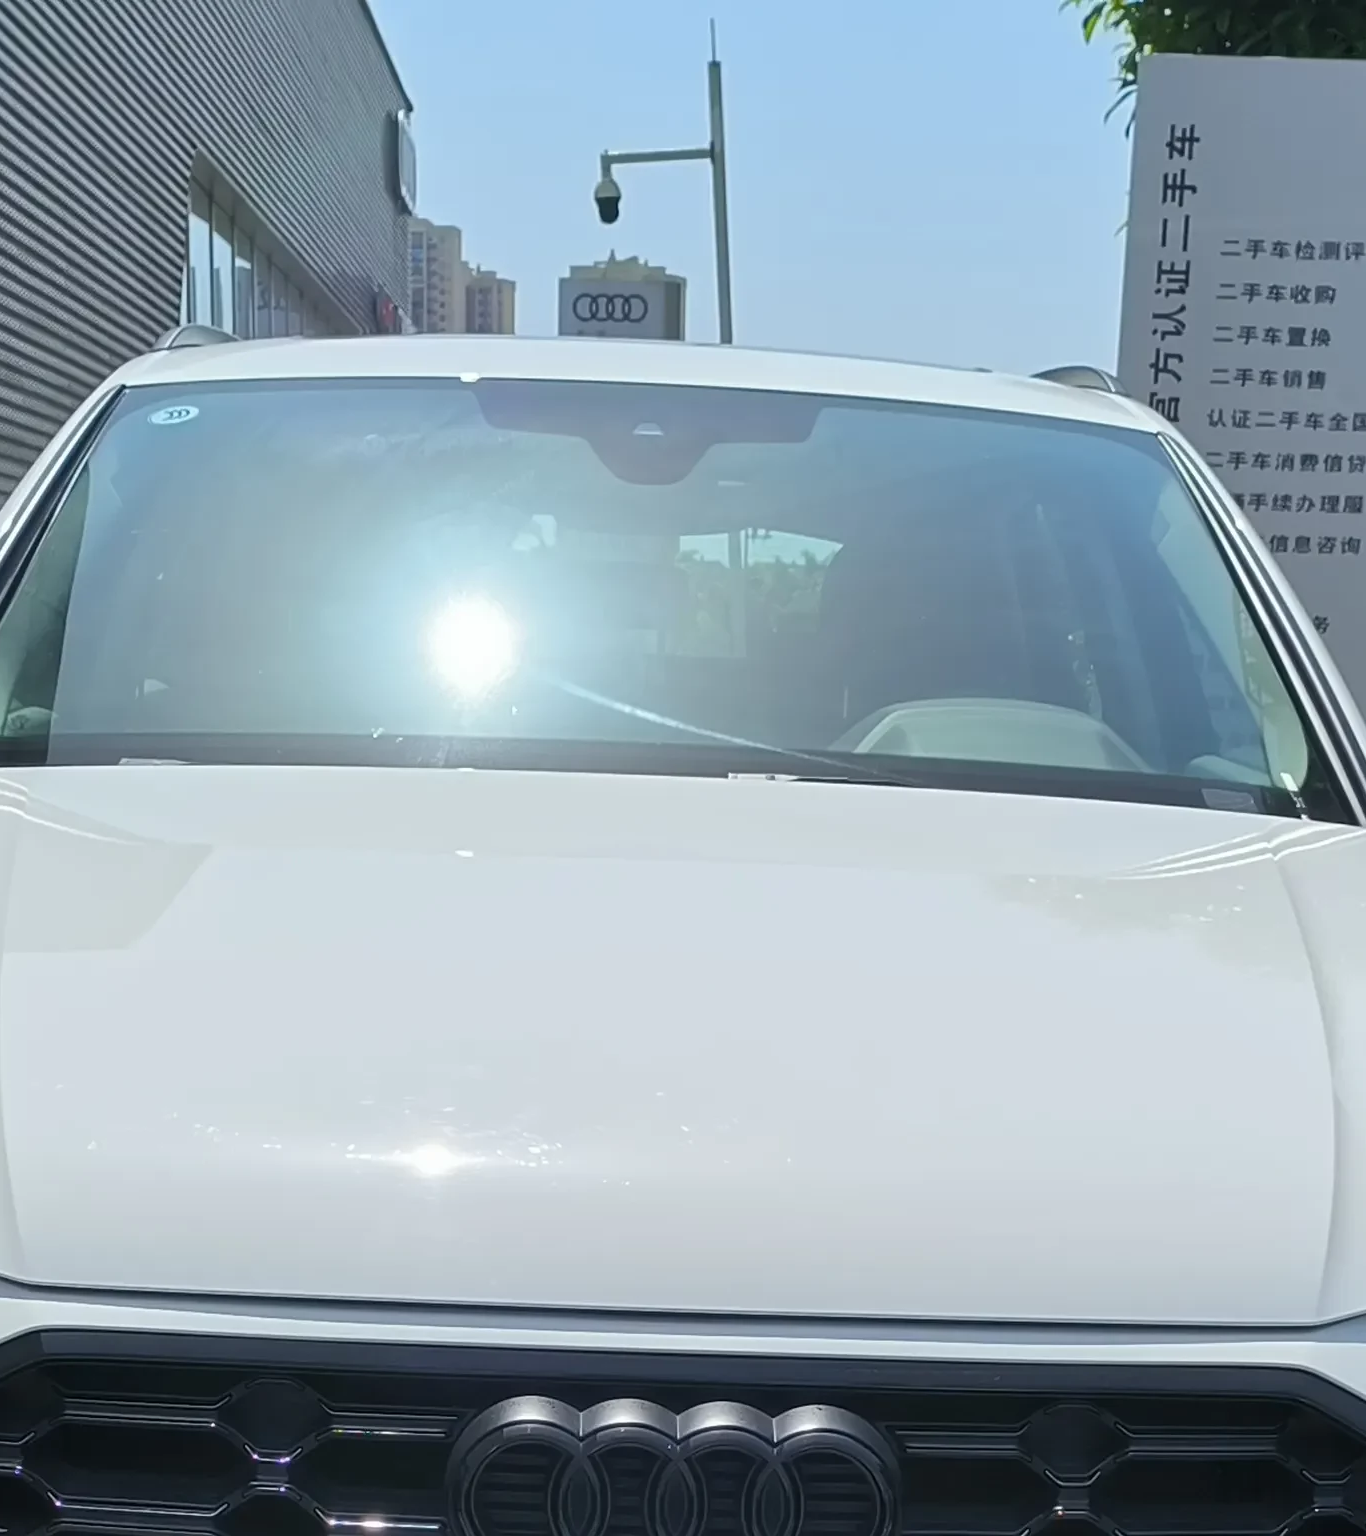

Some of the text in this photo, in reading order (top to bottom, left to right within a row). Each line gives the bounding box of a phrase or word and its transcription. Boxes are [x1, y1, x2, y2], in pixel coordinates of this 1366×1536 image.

[1216, 282, 1337, 305] 二手车收购
[1212, 325, 1331, 348] 二手车置换
[1209, 368, 1327, 391] 二手车销售
[1206, 451, 1366, 473] 二手车消费信贷
[1260, 534, 1361, 555] 信息咨询
